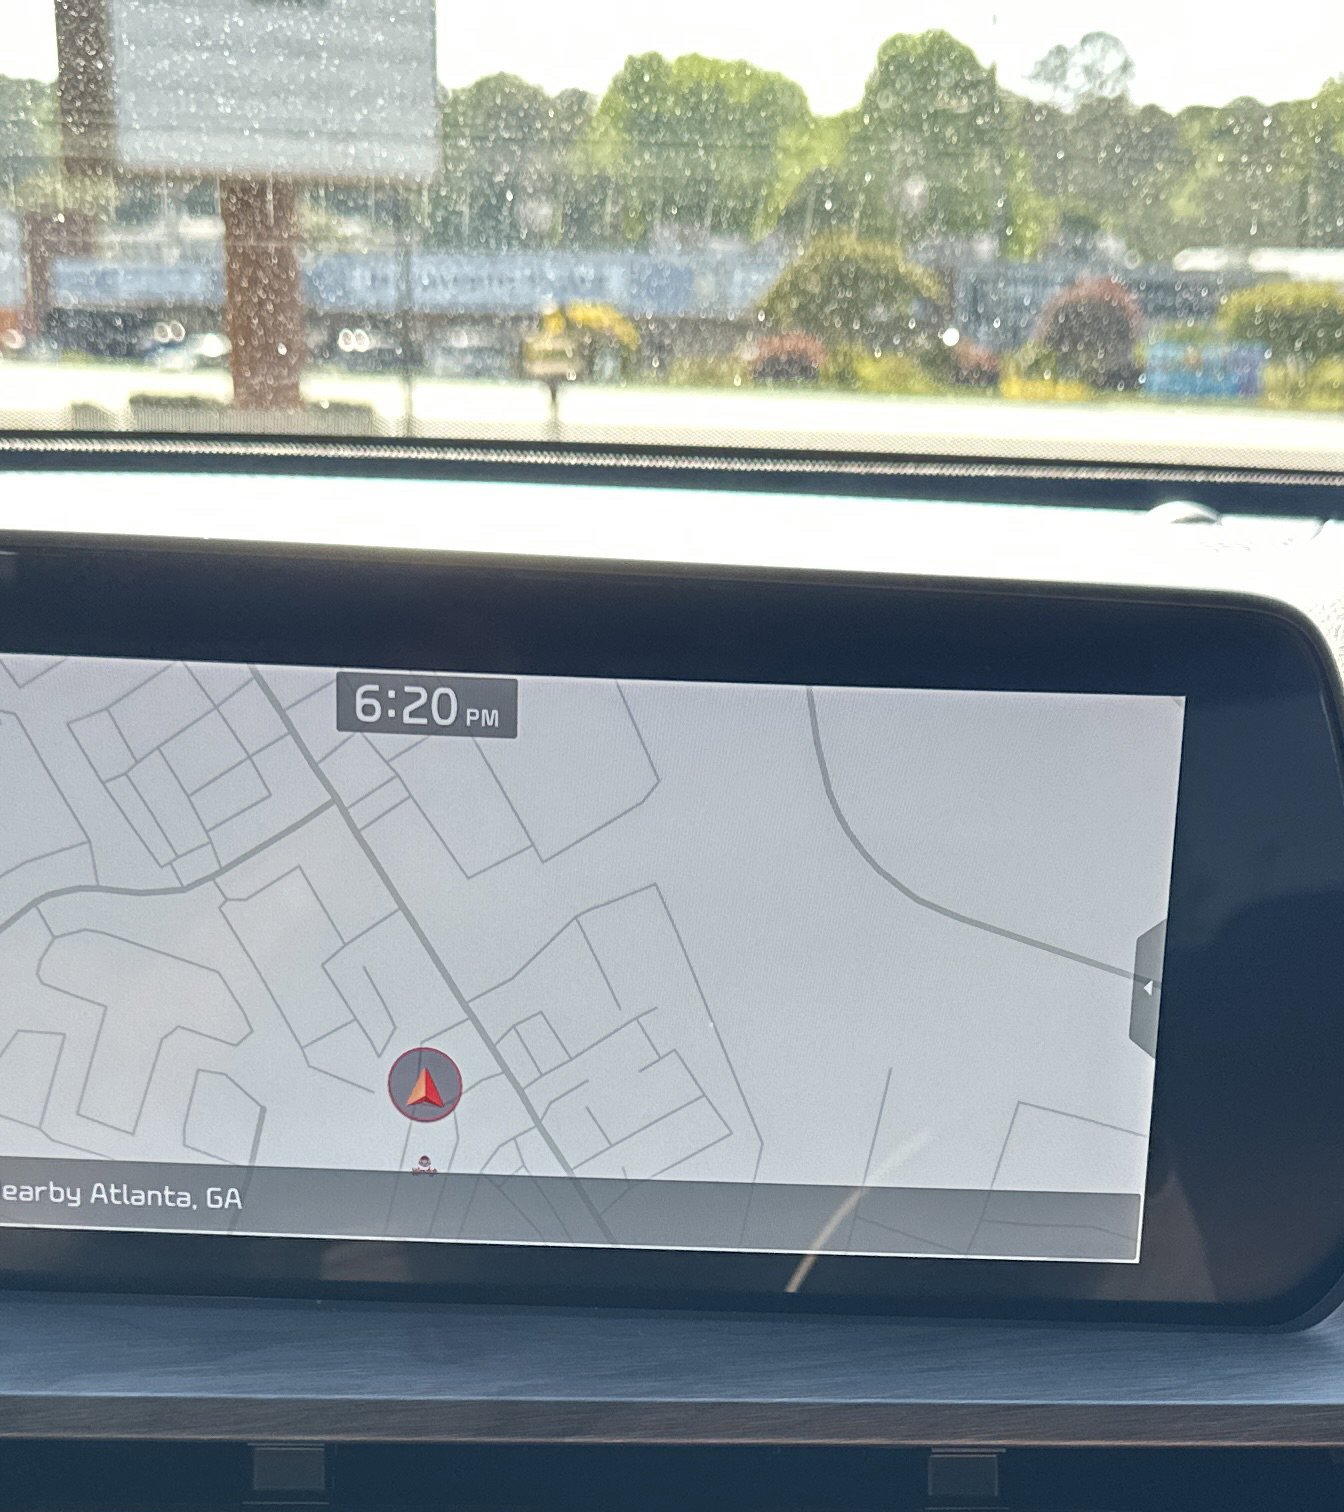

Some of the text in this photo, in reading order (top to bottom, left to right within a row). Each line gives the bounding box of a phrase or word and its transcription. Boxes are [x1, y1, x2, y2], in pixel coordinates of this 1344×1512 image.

[355, 684, 499, 728] 6:20 PM
[89, 1182, 199, 1211] Atlanta,
[206, 1187, 244, 1210] GA
